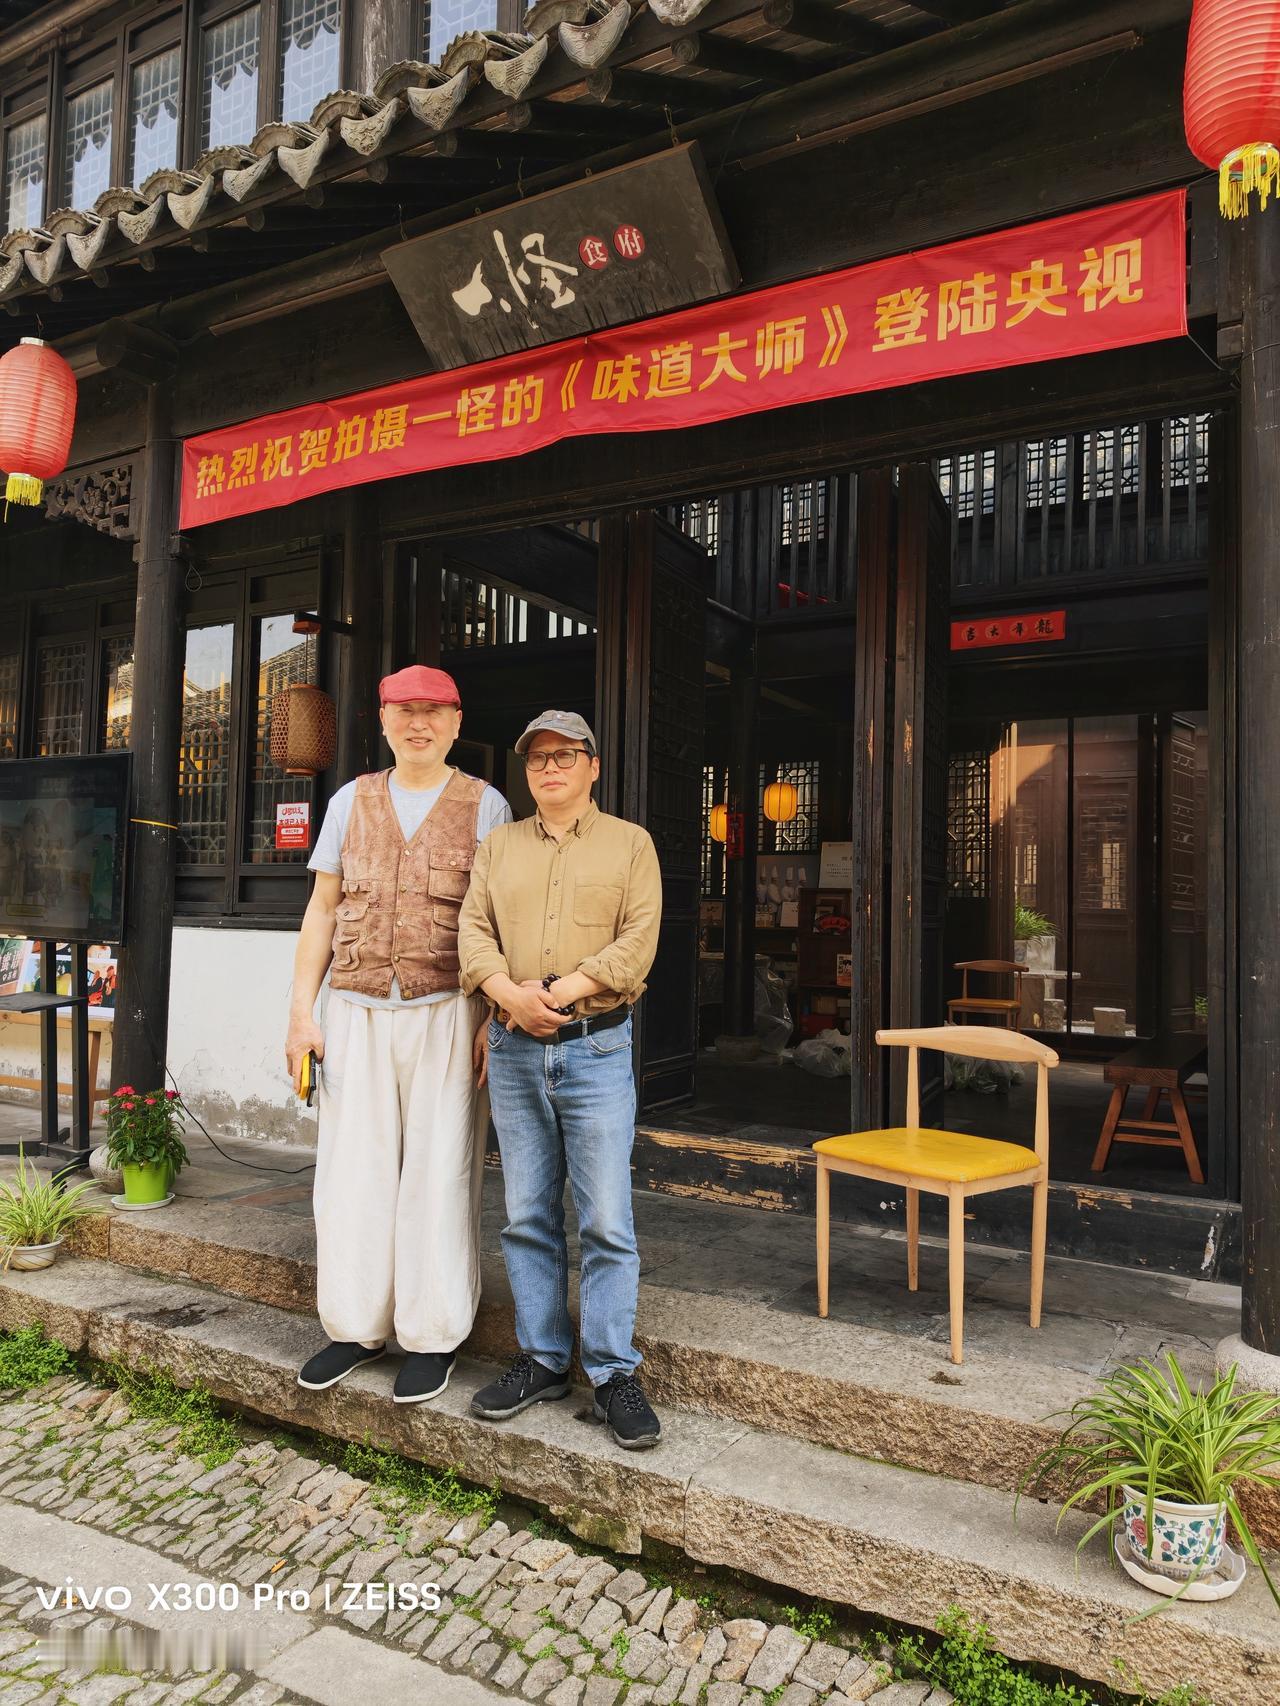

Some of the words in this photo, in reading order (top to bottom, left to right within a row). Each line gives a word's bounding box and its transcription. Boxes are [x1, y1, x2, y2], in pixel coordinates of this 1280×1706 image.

[582, 227, 643, 267] 食府
[195, 238, 1144, 499] 热烈祝贺拍摄一怪的《味道大师》登陆央视
